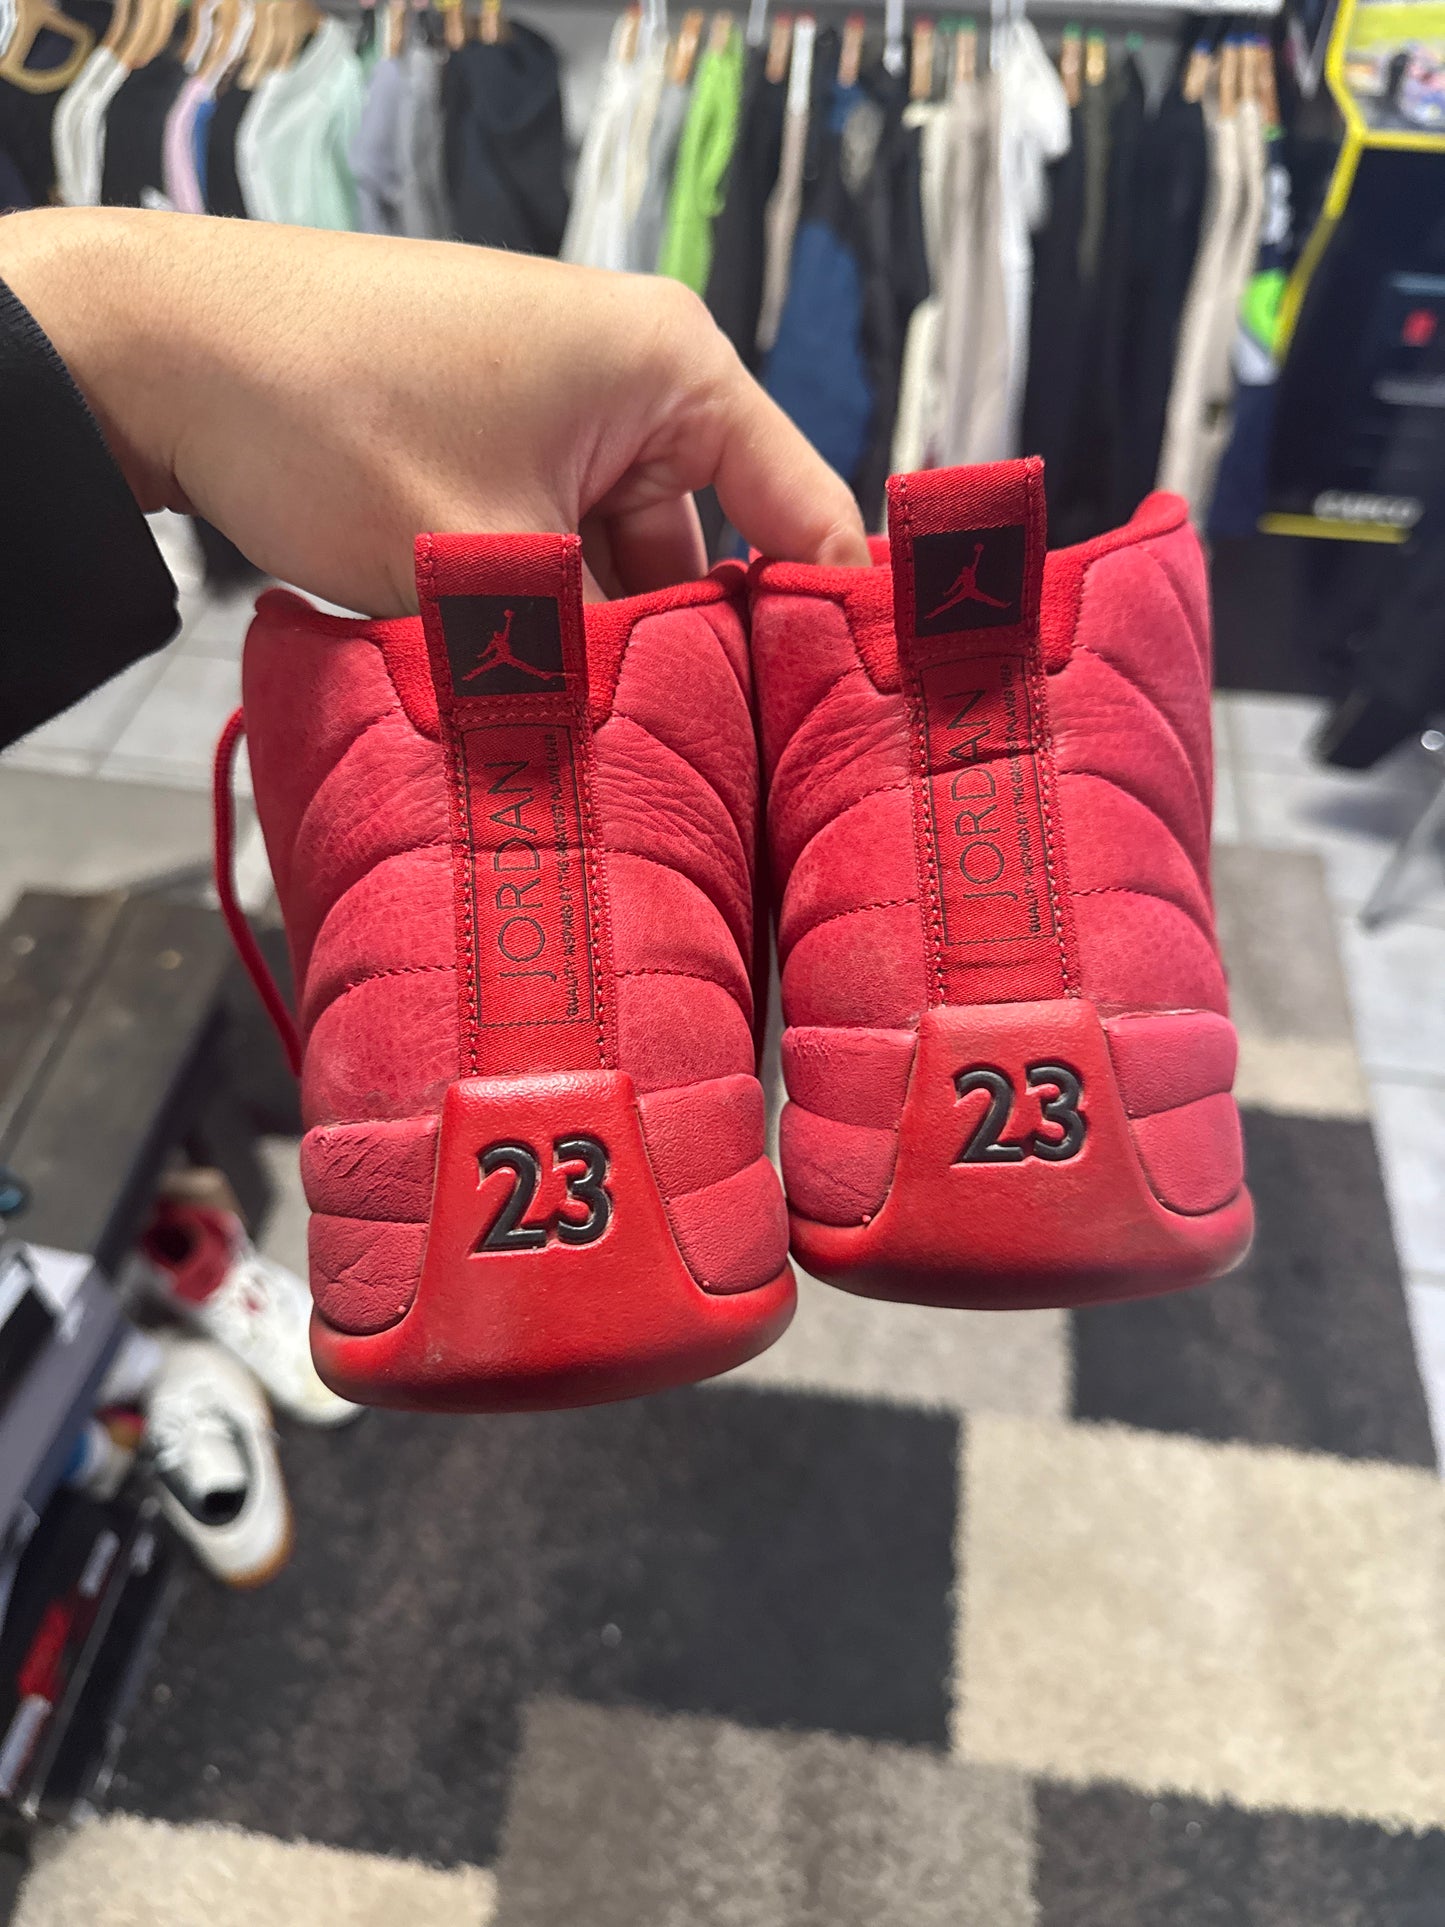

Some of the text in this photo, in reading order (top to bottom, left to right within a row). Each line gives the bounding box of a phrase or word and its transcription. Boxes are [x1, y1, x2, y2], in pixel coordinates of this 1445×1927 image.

[1005, 736, 1023, 784] GREAST
[943, 689, 1018, 901] JORDAN
[1015, 810, 1028, 825] BY
[485, 759, 557, 982] JORDAN
[557, 861, 570, 881] THE
[559, 885, 572, 901] BY
[560, 905, 575, 956] INSPIRED
[1024, 880, 1041, 932] QUALITY
[563, 960, 579, 1016] QUALITY
[951, 1058, 1089, 1164] 23
[472, 1132, 614, 1255] 23
